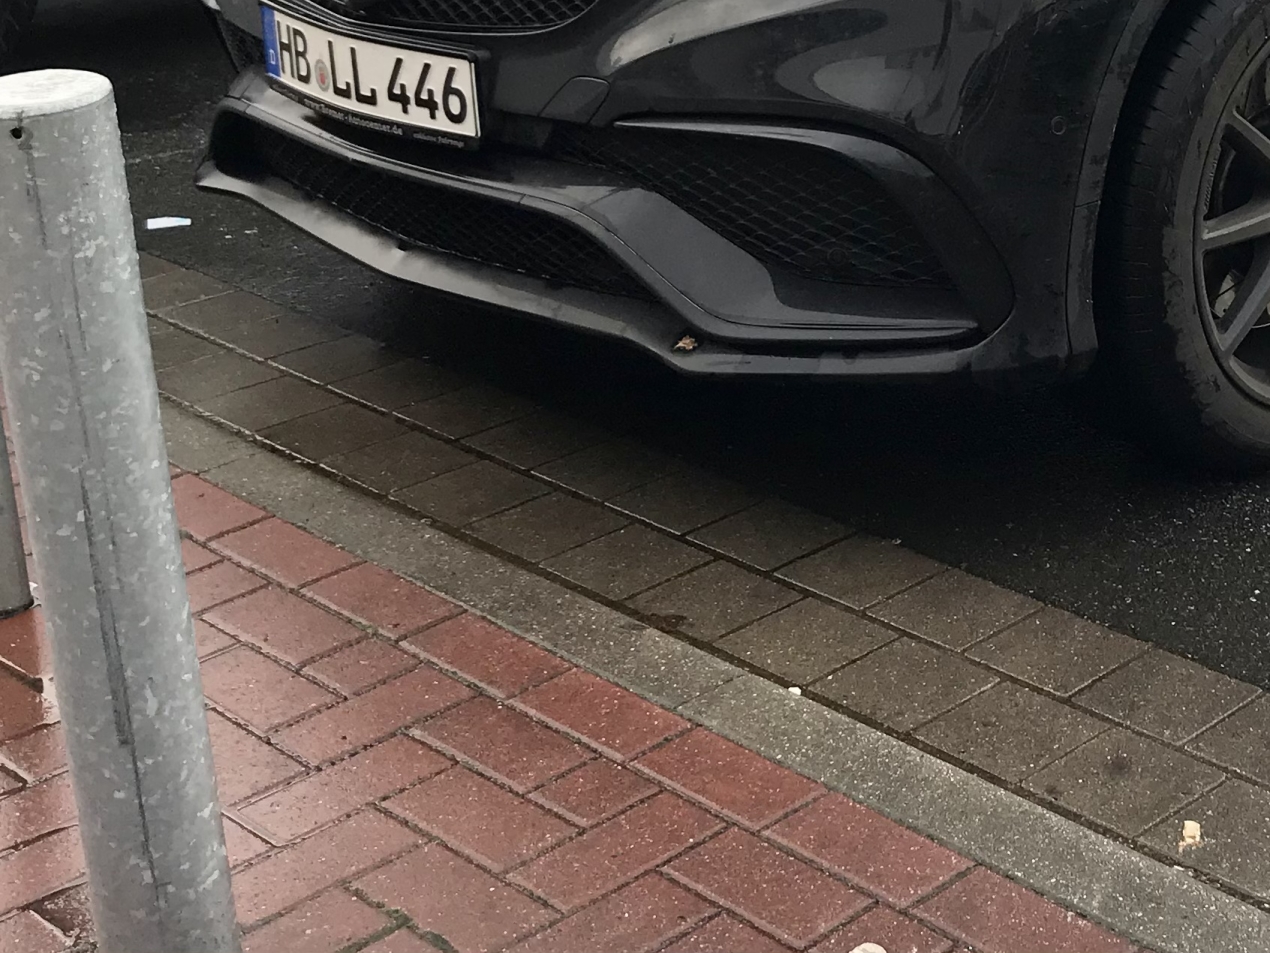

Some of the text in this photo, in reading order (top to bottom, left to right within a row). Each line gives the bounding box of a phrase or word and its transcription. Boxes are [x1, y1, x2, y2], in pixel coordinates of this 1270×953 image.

[269, 49, 276, 65] D
[276, 19, 468, 124] HB LL 446
